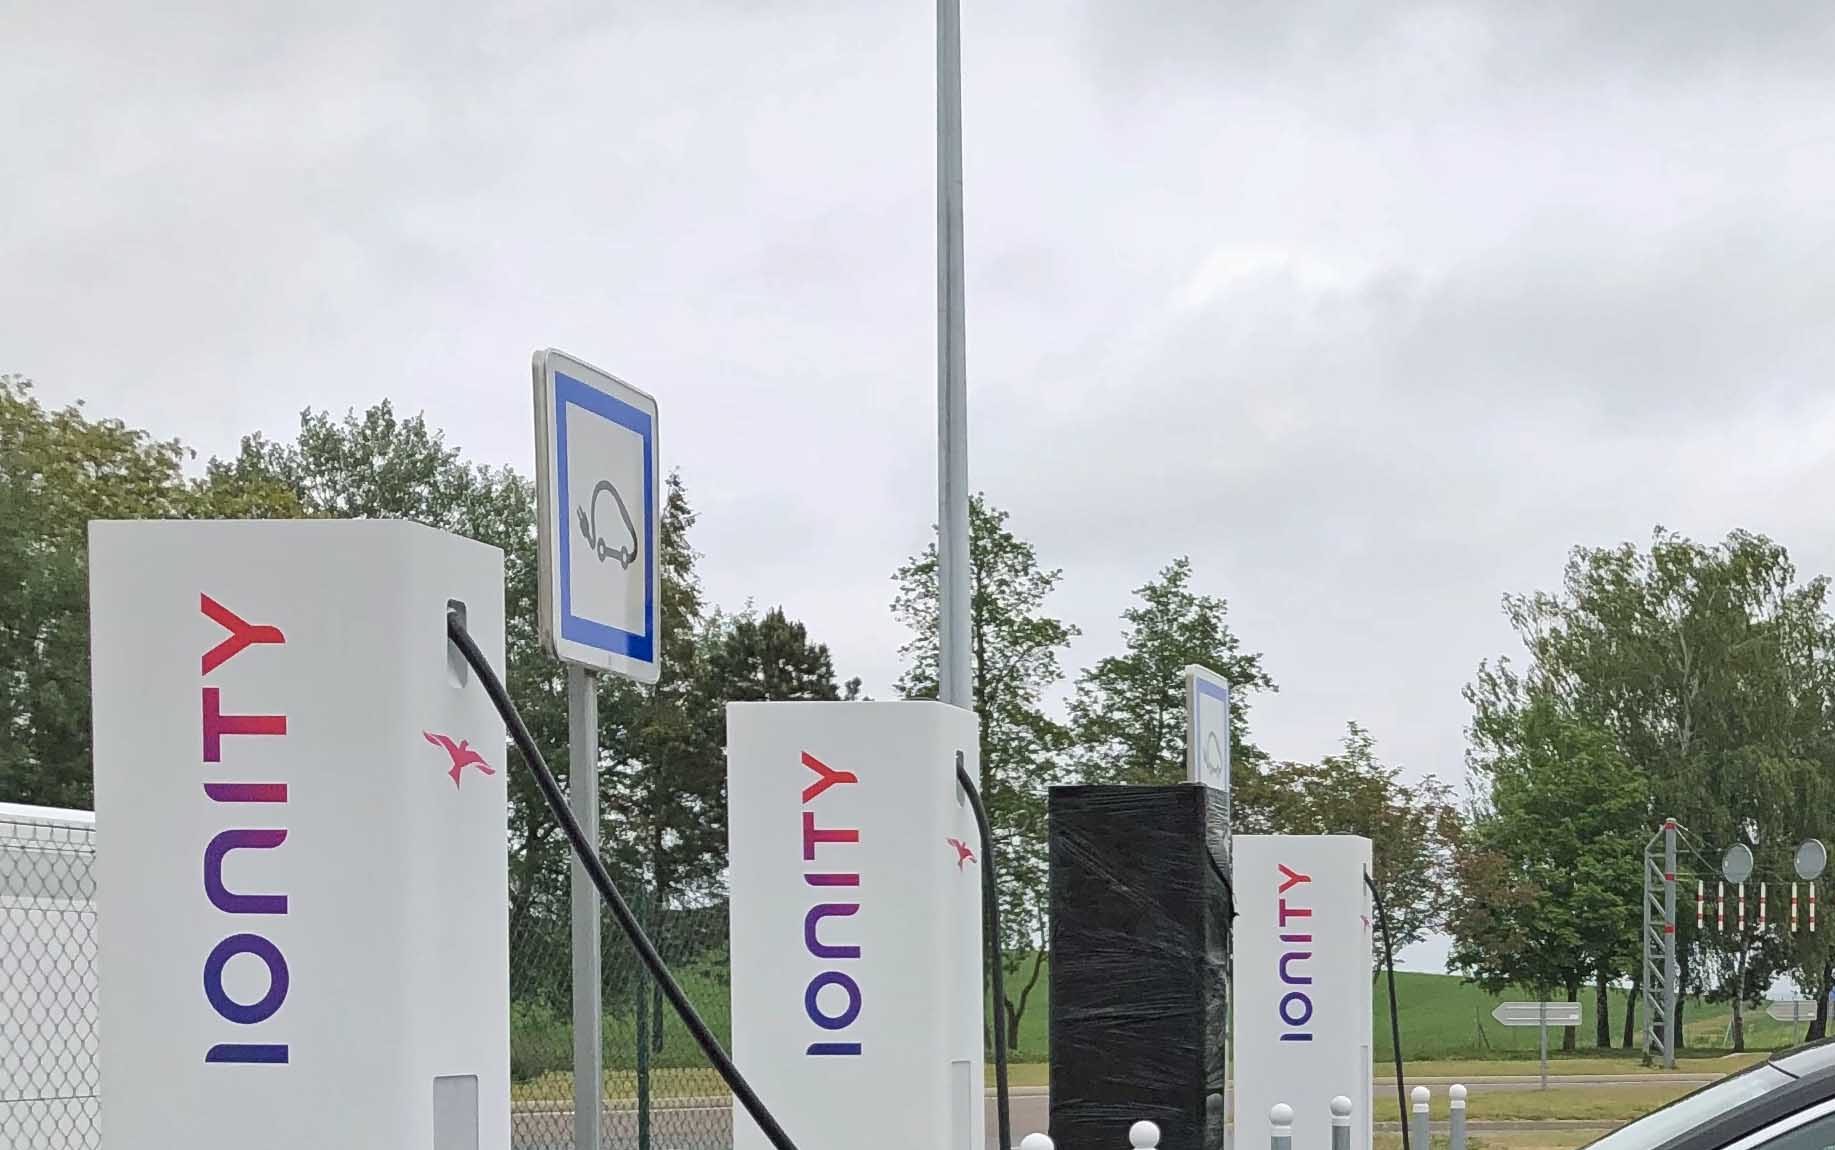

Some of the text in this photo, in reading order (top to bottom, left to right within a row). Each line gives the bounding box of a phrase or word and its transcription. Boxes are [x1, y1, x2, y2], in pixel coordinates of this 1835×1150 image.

[200, 592, 290, 1064] IONITY
[801, 750, 862, 1056] IONITY
[1277, 862, 1313, 1041] IONITY
